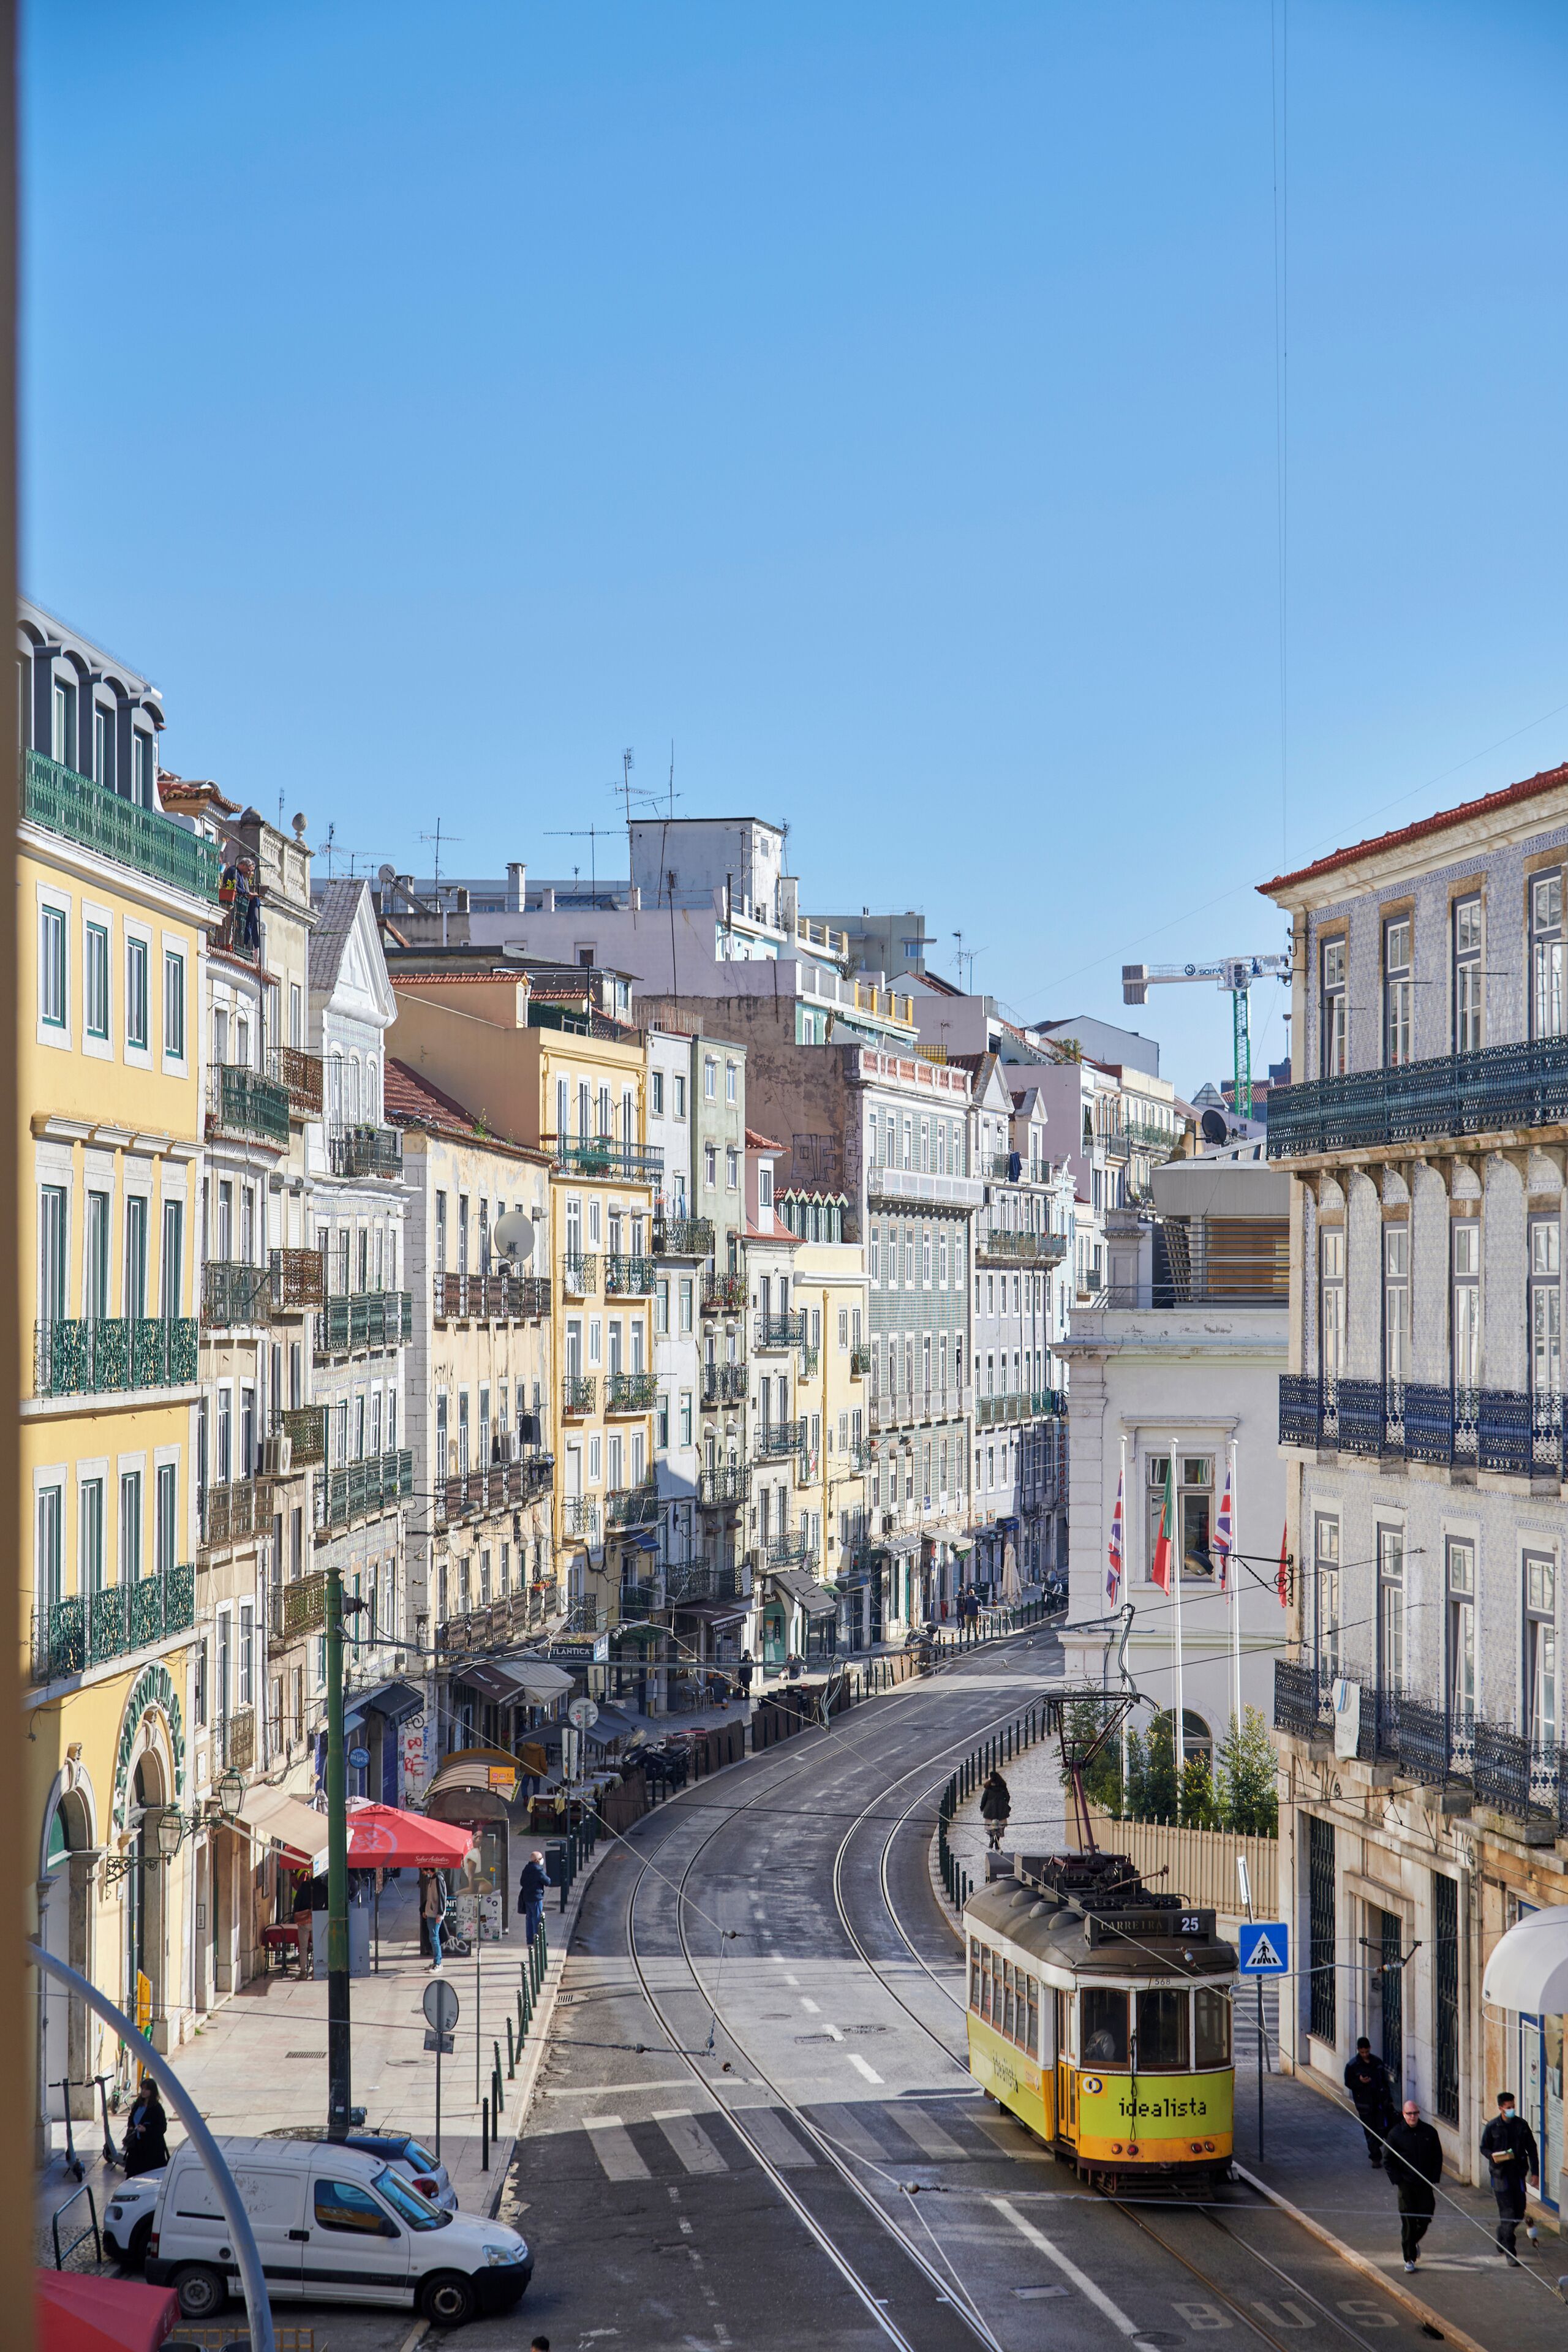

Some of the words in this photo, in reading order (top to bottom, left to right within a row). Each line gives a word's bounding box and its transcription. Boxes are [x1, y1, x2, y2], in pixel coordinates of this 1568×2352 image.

[551, 1646, 590, 1655] TLANTICA
[1101, 1920, 1163, 1931] CARREIRA
[1181, 1917, 1199, 1931] 25
[1118, 2097, 1207, 2117] idealista
[1171, 2301, 1400, 2330] BUS
